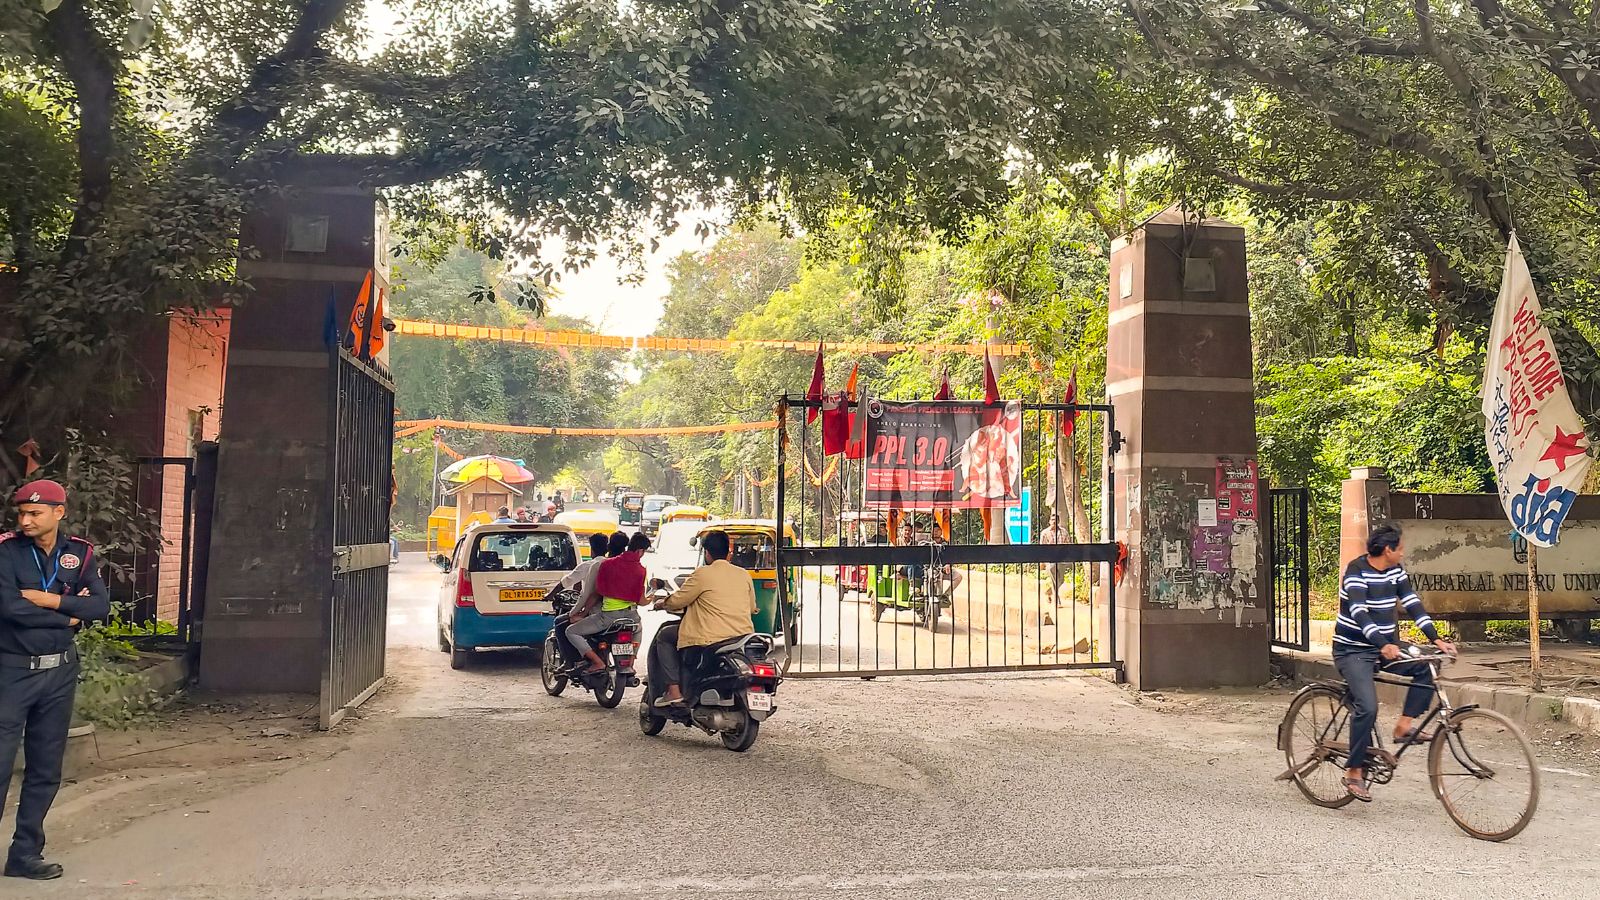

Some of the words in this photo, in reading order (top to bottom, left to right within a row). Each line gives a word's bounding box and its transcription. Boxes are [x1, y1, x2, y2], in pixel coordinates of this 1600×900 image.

[1513, 296, 1564, 401] WELCOME
[871, 435, 907, 465] PPL
[912, 436, 948, 466] 3.0
